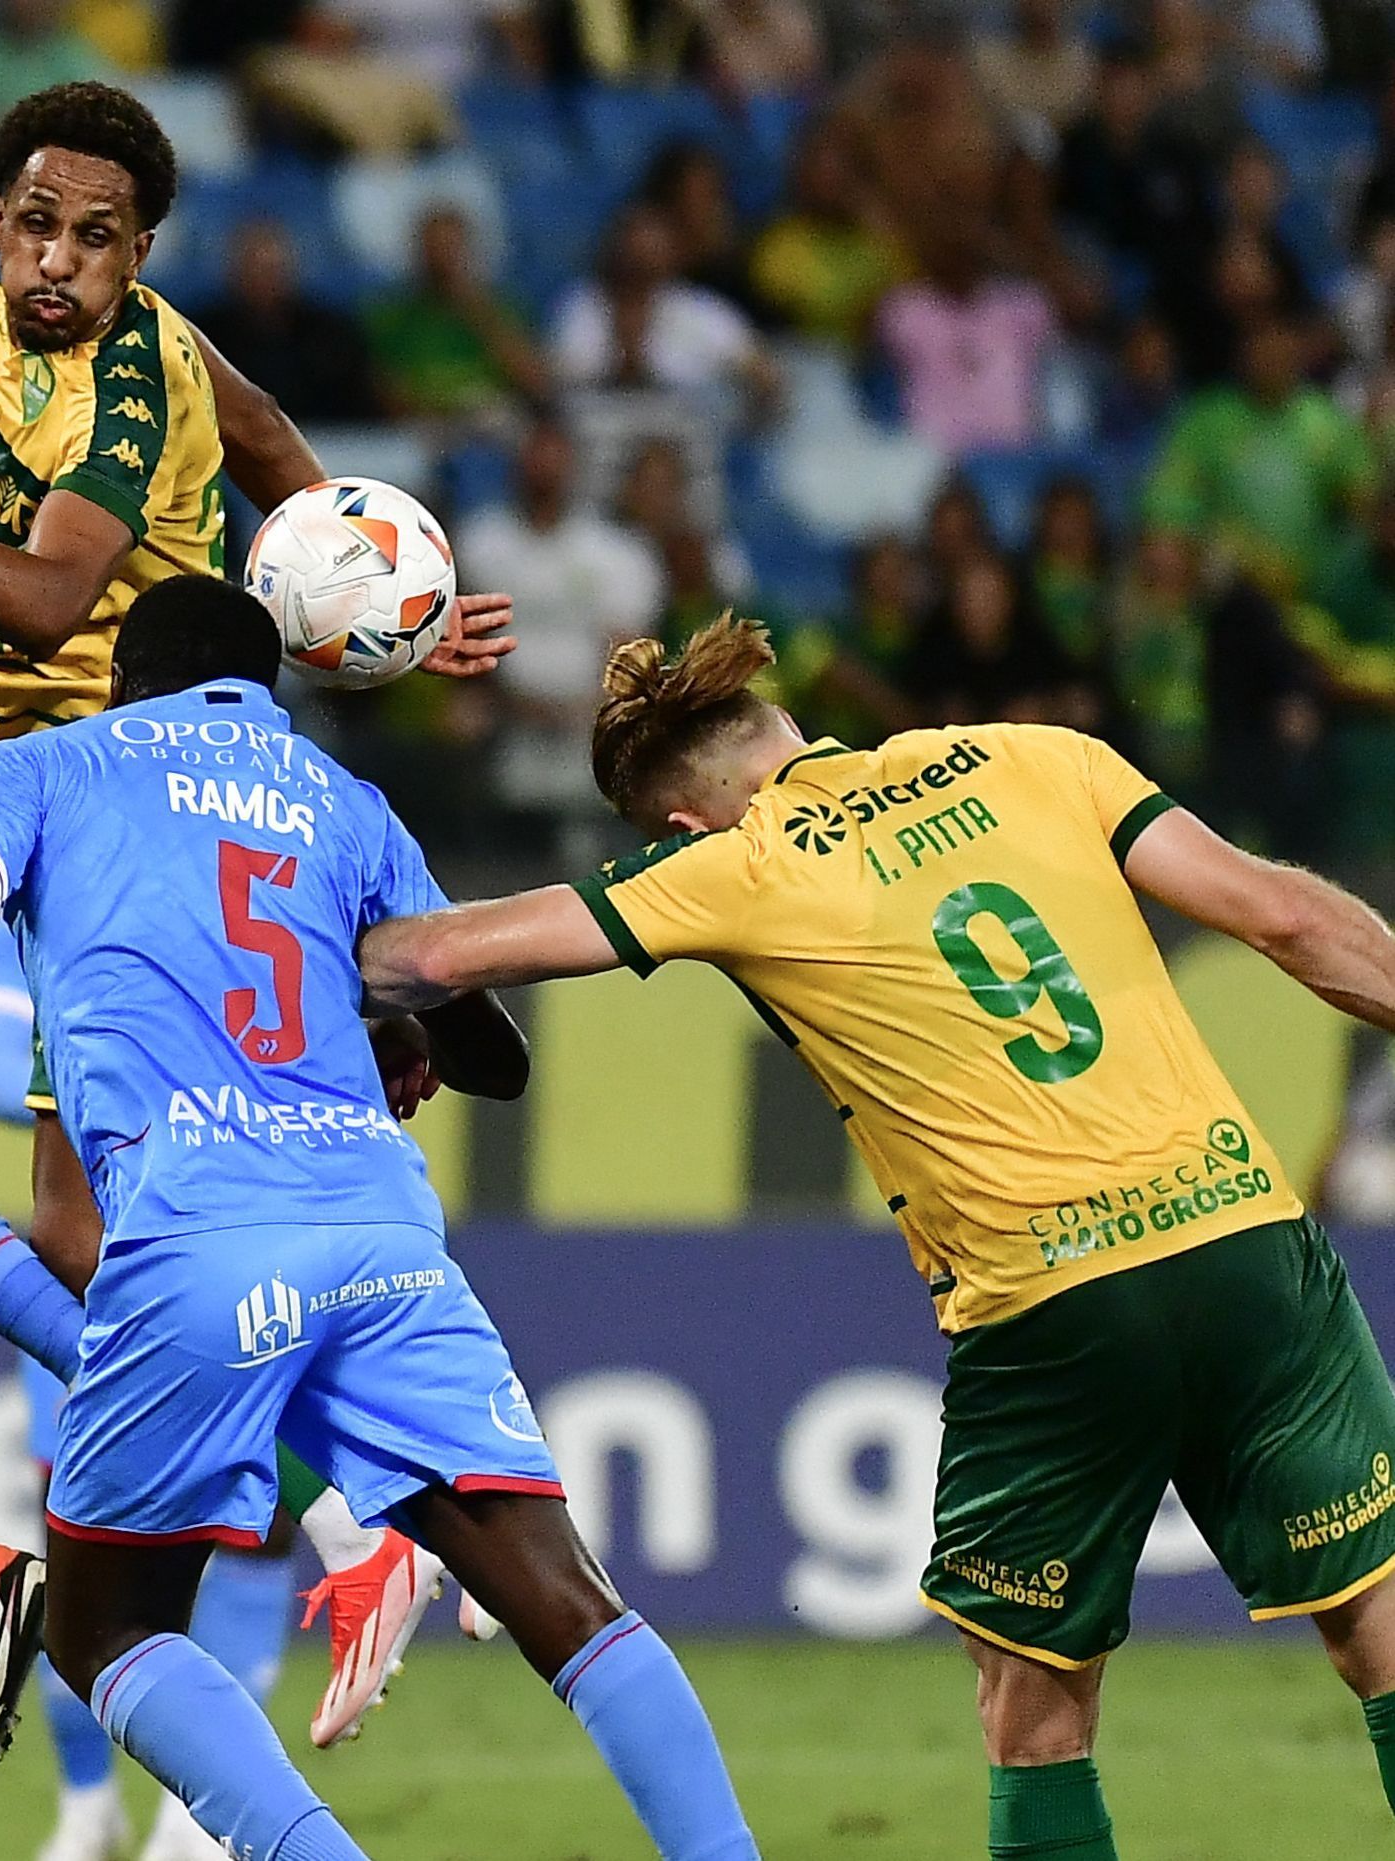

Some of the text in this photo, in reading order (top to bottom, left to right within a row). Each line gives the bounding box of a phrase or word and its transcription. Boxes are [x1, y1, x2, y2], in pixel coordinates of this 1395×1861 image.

[166, 772, 316, 847] RAMOS
[840, 738, 991, 823] Sicredi
[894, 796, 1000, 868] PITTA
[216, 839, 307, 1065] 5
[931, 881, 1105, 1085] 9
[1027, 1152, 1228, 1238] CONHEÇA
[1039, 1166, 1273, 1268] MATO GROSSO
[308, 1277, 389, 1314] AZIENDA
[390, 1268, 446, 1291] VERDE
[1283, 1477, 1381, 1534] CONHEÇA
[1288, 1520, 1345, 1553] MATO
[992, 1580, 1064, 1609] GROSSO
